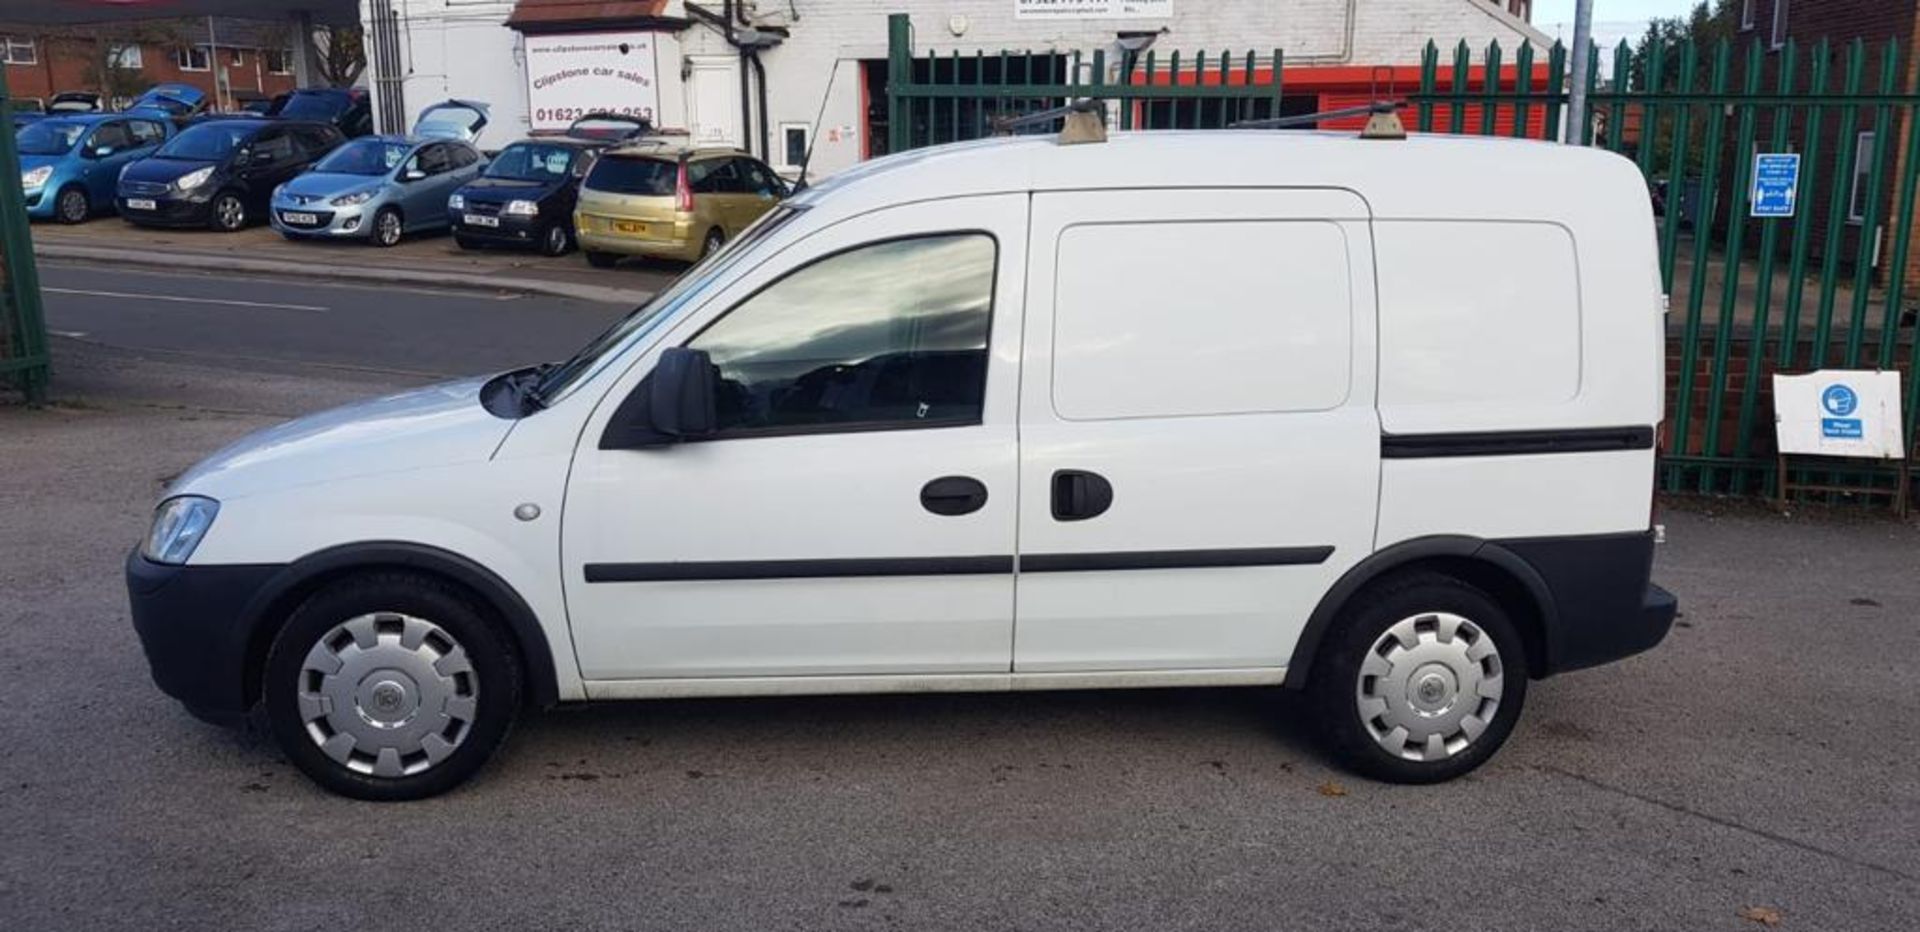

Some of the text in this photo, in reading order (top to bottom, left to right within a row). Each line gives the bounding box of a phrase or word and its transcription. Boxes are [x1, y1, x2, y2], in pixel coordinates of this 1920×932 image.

[533, 66, 650, 90] Clipstone car sales
